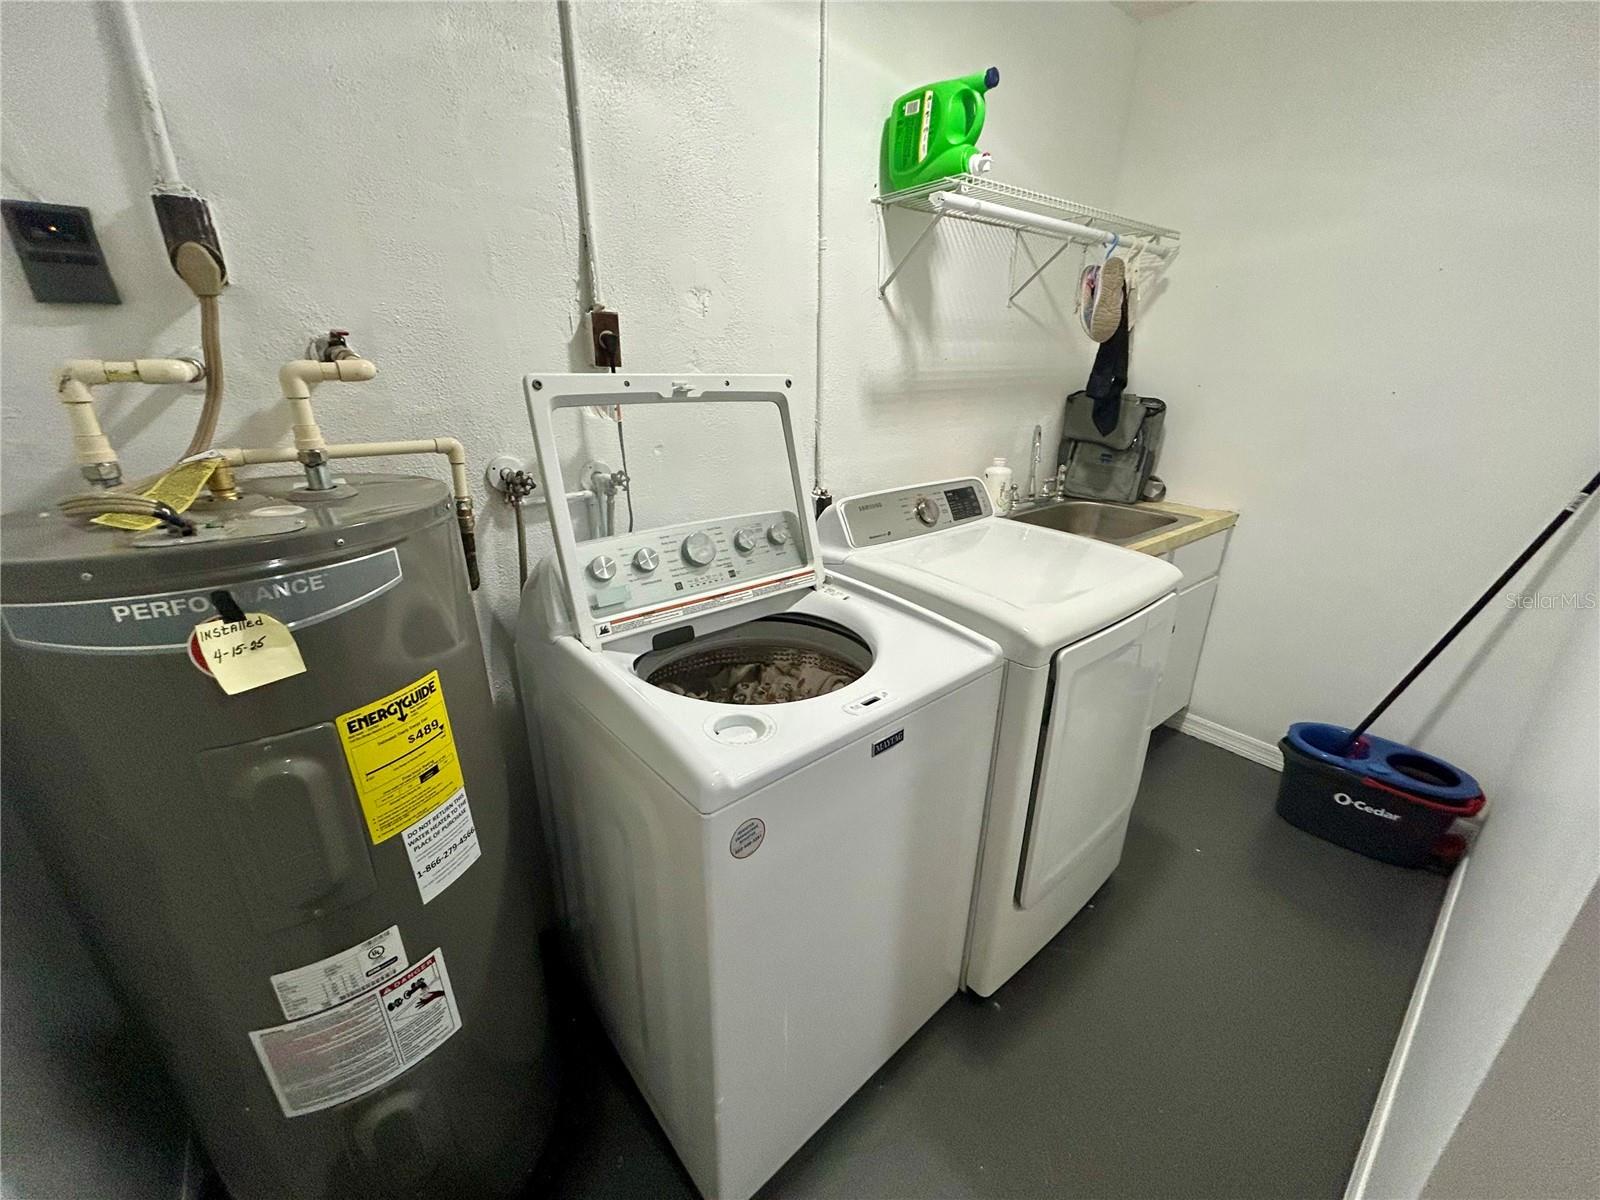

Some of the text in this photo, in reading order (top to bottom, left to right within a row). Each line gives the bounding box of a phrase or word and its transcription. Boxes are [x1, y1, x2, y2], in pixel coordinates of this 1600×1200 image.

[112, 575, 326, 623] PERFOANCE
[213, 635, 267, 664] 4-15-25
[346, 680, 437, 734] ENERGYGUIDE
[407, 829, 418, 839] DO
[418, 819, 432, 833] NOT
[432, 803, 454, 822] RETURN
[1333, 792, 1402, 820] O-Cedar
[407, 830, 430, 847] WATER
[430, 815, 451, 832] HEATER
[450, 807, 459, 817] TO
[413, 807, 467, 852] PLACE OF PURCHASE
[394, 958, 434, 987] DANGER
